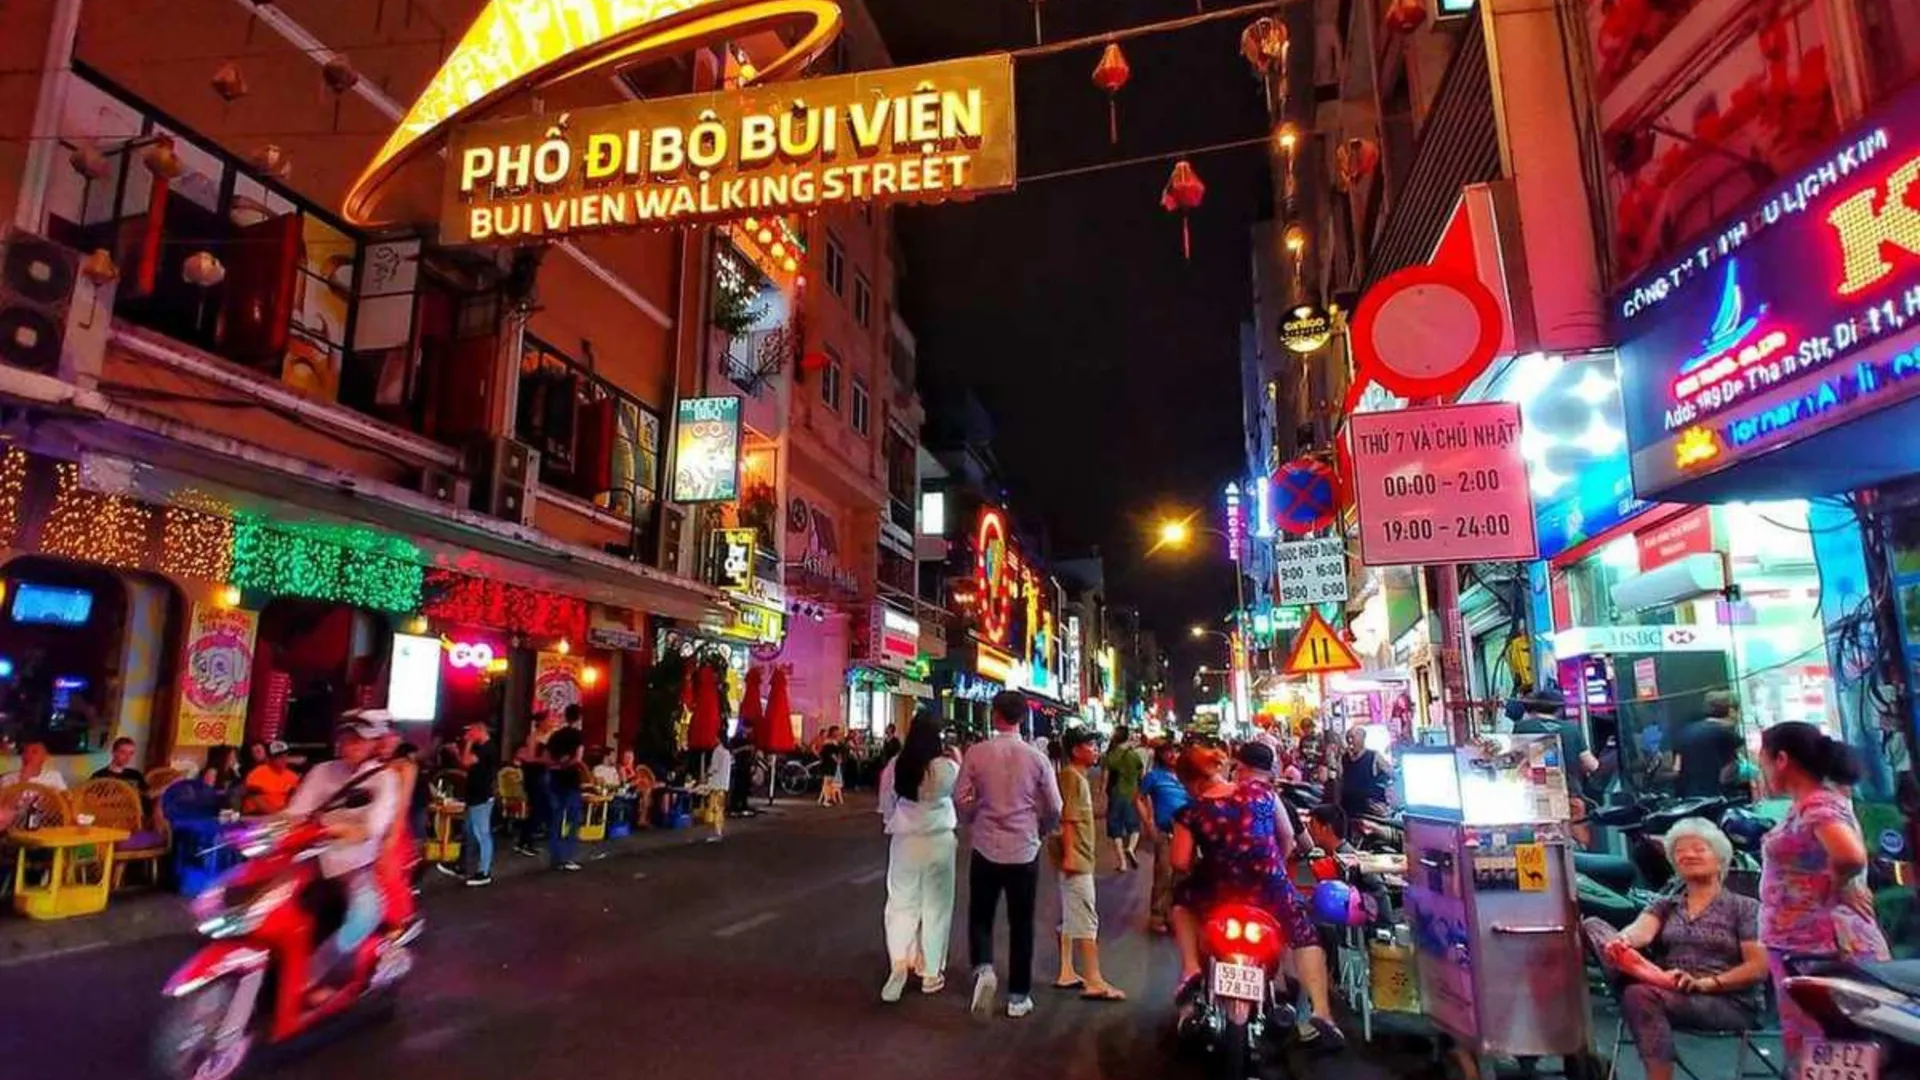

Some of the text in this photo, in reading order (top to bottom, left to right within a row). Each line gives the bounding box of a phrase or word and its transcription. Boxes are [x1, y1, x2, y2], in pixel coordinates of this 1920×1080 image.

[461, 80, 982, 192] PHỐ ĐI BỘ BÙI VIỆN
[1837, 127, 1888, 175] KIM
[470, 154, 971, 240] BUI VIEN WALKING STREET
[1359, 418, 1517, 455] THỨ 7 VÀ CHỦ NHẬT
[1384, 473, 1436, 497] 00:00
[1458, 469, 1499, 493] 2:00
[1382, 519, 1433, 542] 19:00
[1455, 513, 1510, 538] 24:00
